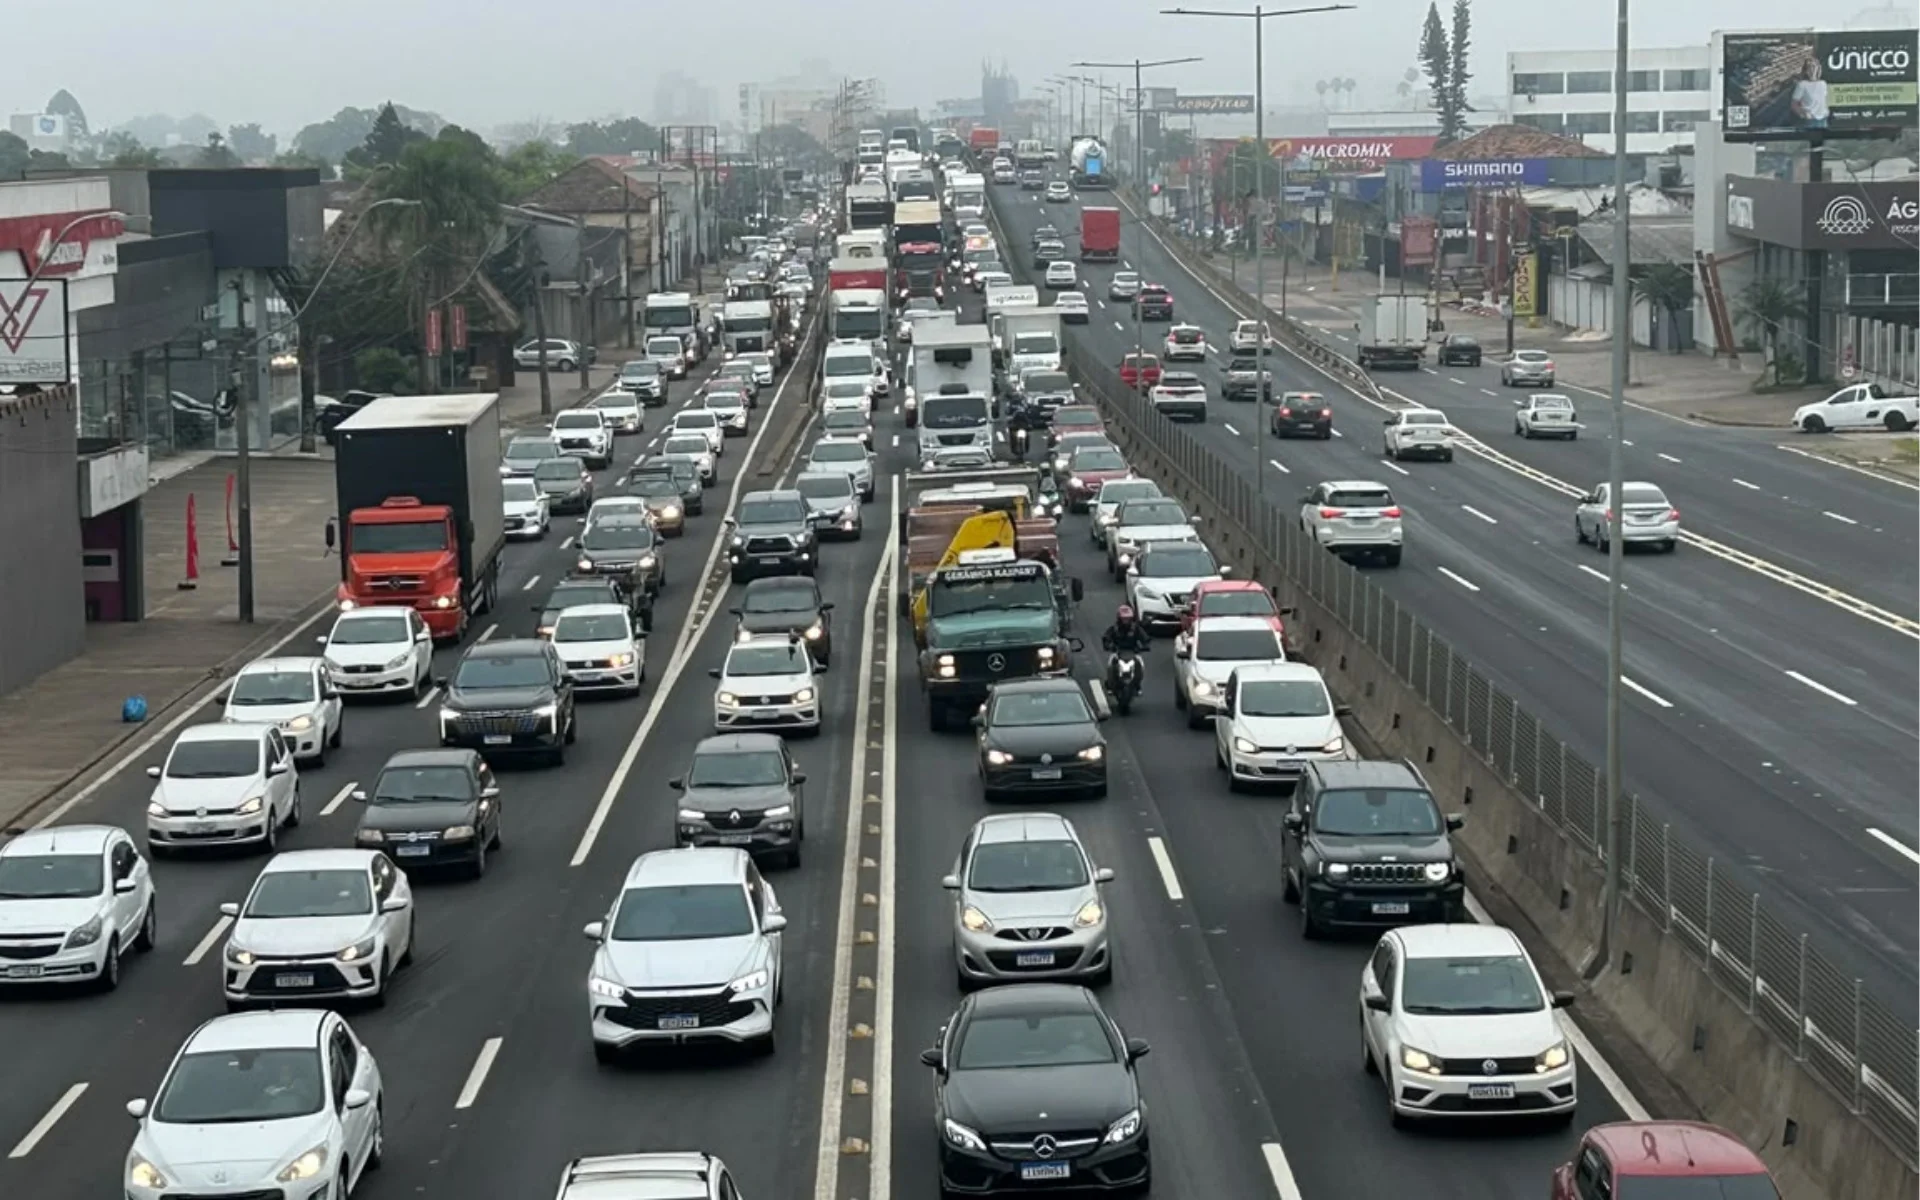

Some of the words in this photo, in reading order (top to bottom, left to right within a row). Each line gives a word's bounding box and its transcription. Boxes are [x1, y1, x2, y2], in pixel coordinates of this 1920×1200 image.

[1178, 97, 1249, 110] GOODYEAR
[1300, 143, 1393, 158] MACROMIX
[1445, 163, 1524, 176] SHIMANO
